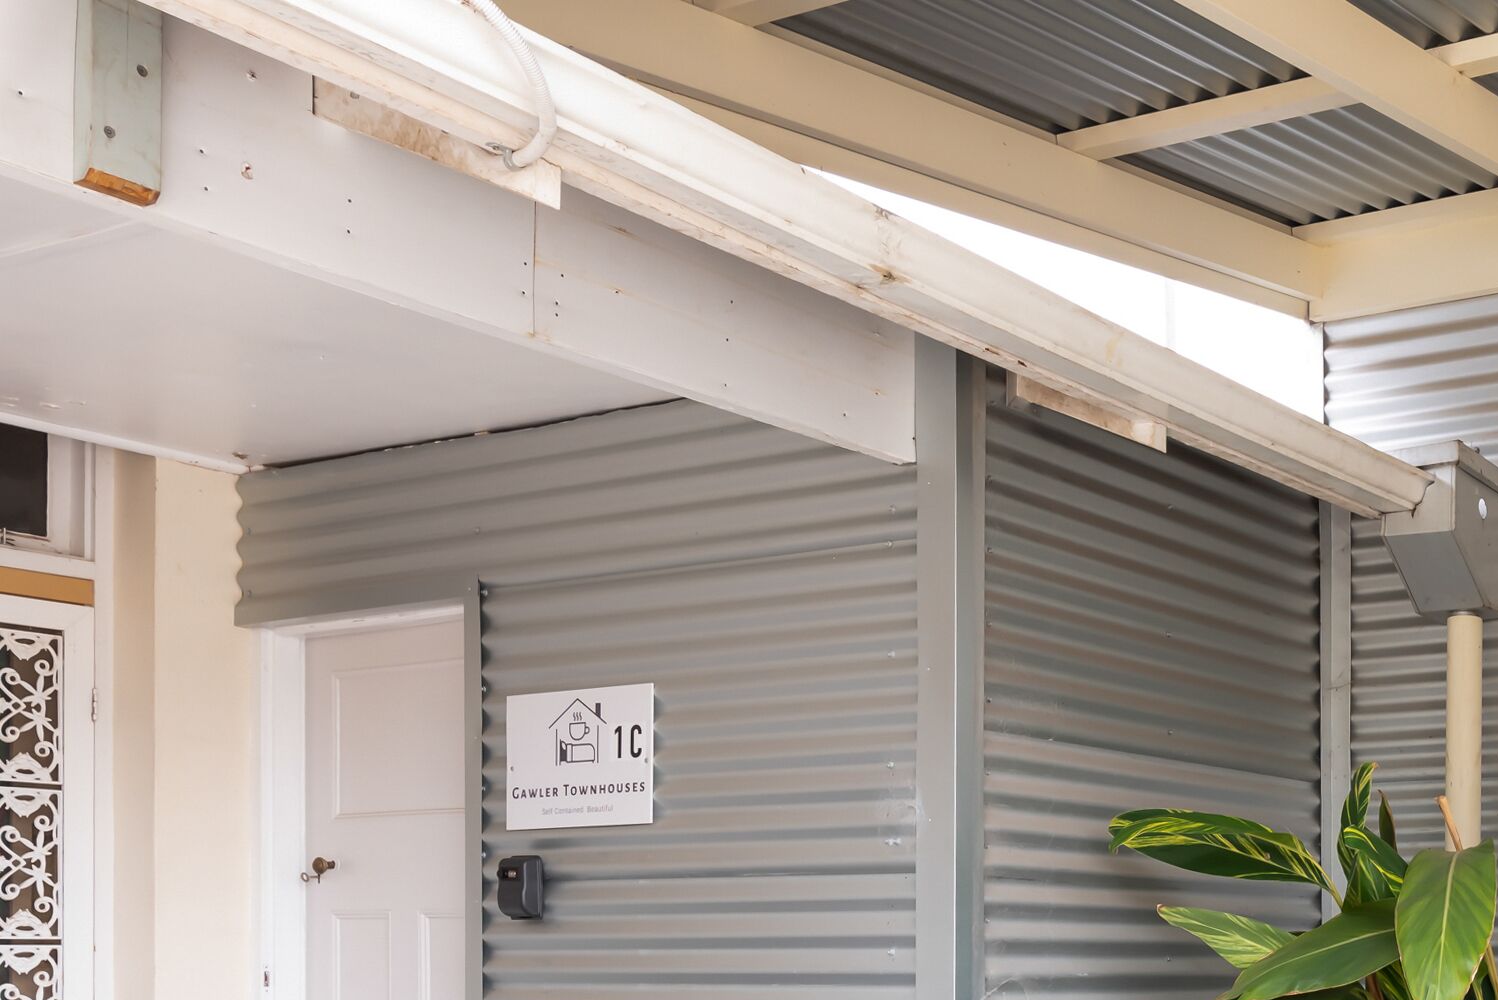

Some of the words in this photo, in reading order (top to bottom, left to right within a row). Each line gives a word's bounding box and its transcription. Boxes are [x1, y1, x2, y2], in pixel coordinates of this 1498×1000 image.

[614, 724, 643, 759] 1C
[512, 786, 559, 799] GAWLER
[563, 781, 646, 797] TOWNHOUSES
